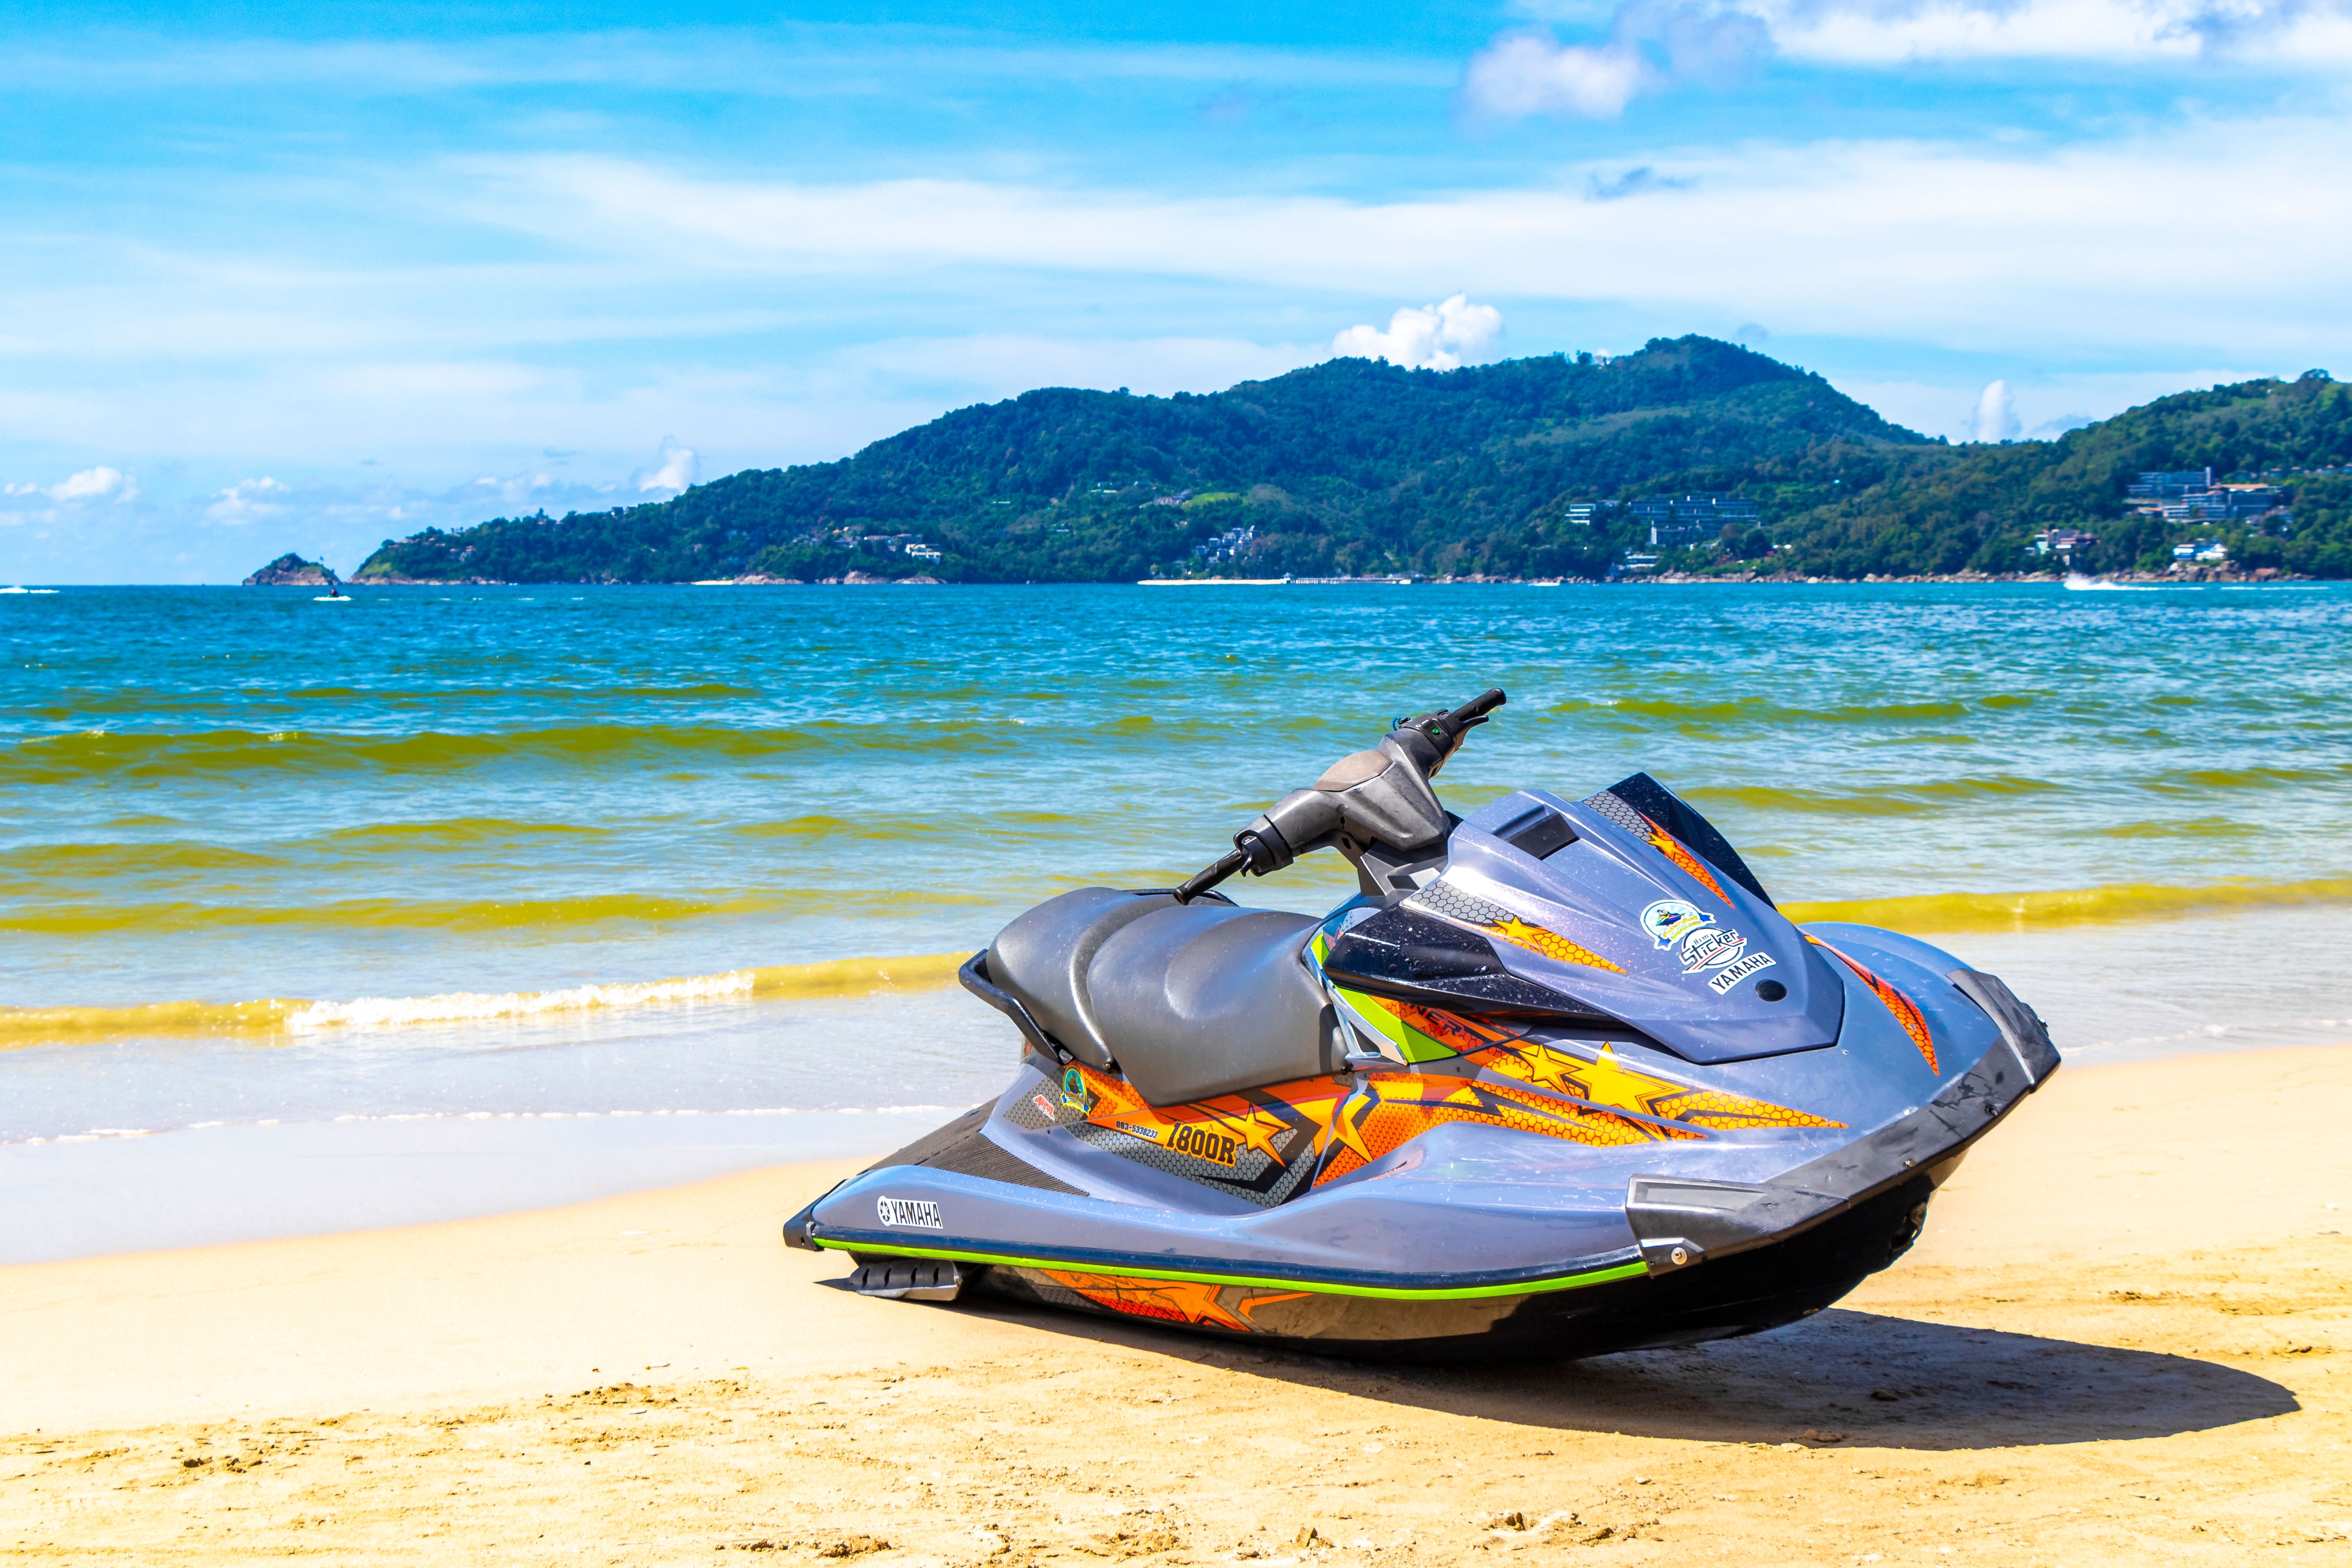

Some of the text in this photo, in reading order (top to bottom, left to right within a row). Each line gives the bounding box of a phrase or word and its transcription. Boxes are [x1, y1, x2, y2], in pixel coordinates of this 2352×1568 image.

[1681, 930, 1736, 964] Sticker
[1711, 954, 1772, 990] YAMAHA
[1116, 1121, 1158, 1138] 083-5338233
[1166, 1123, 1235, 1164] 1800R
[891, 1201, 941, 1227] YAMAHA
